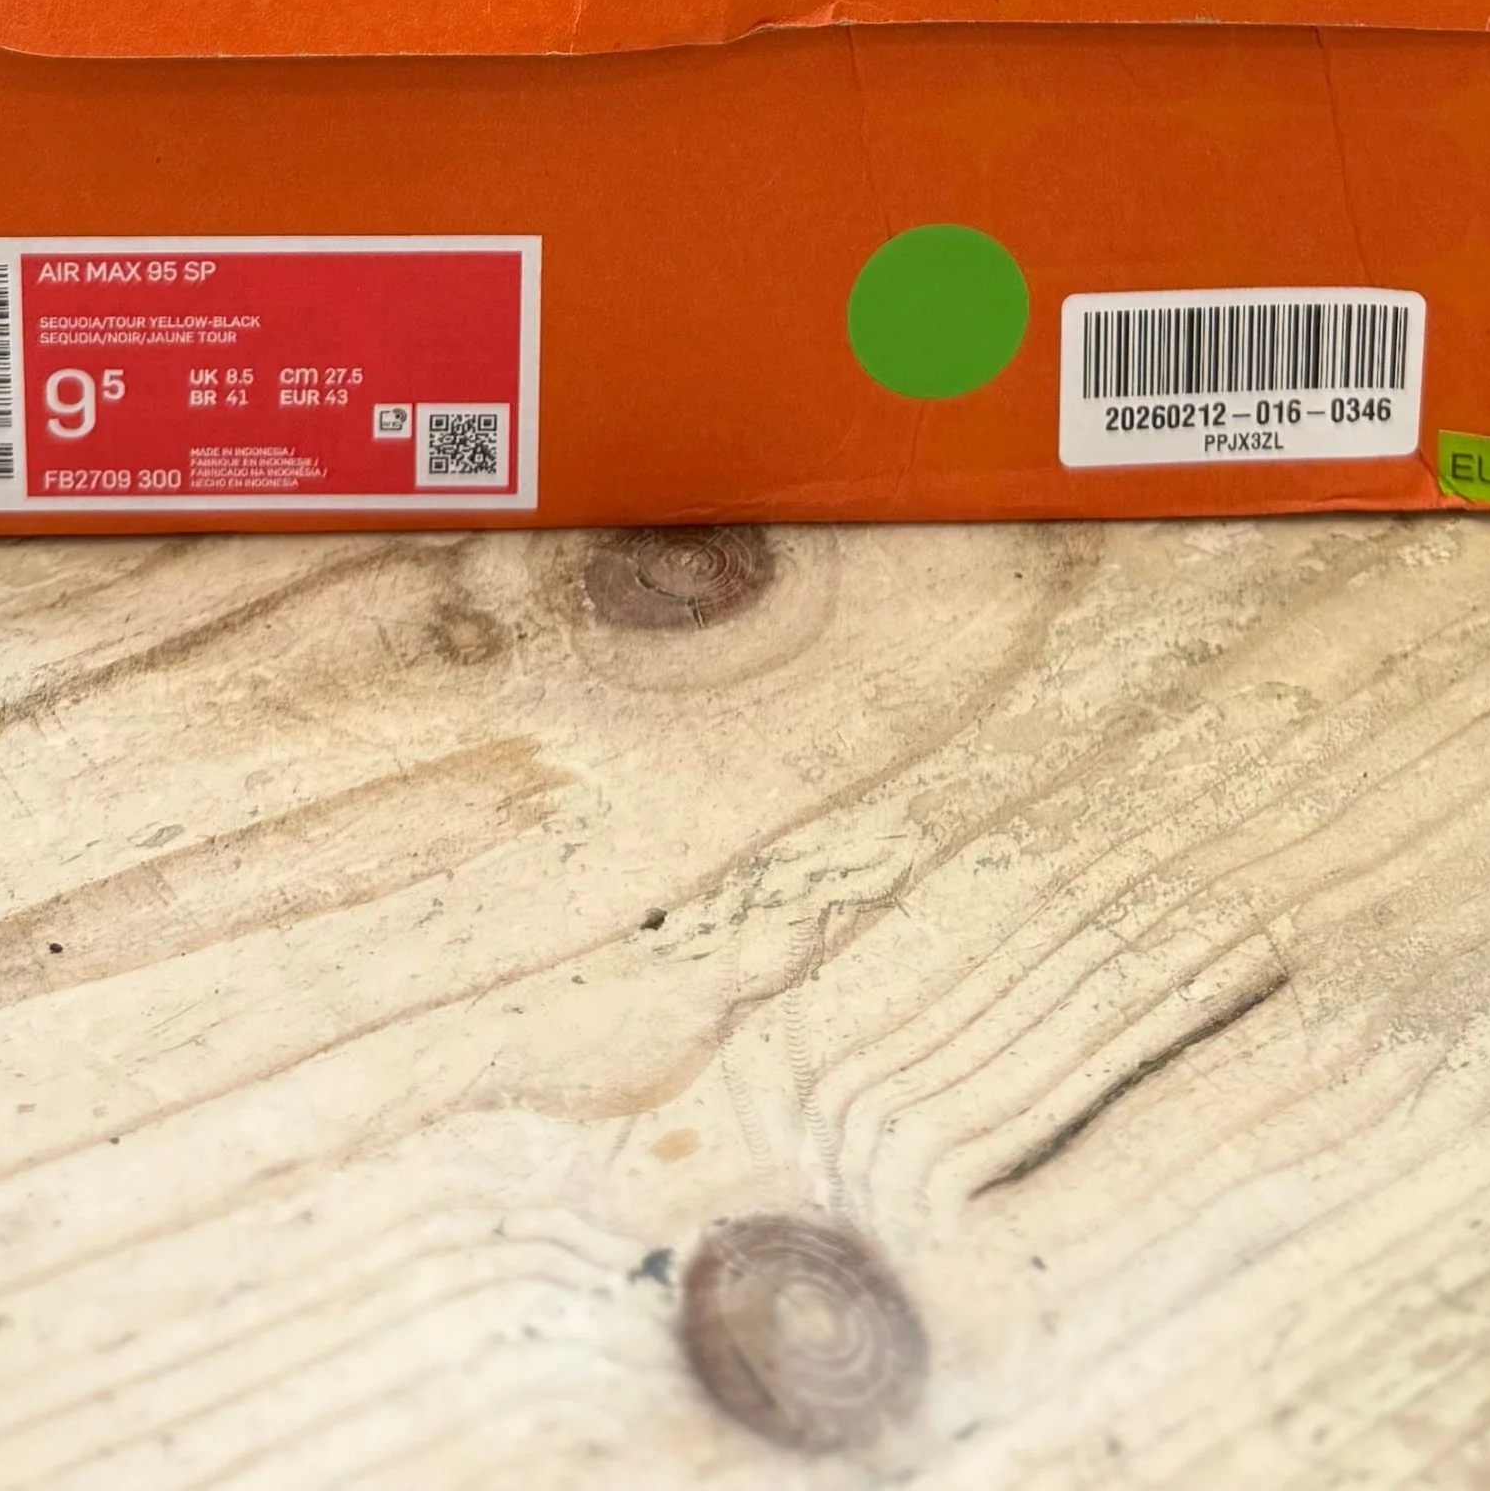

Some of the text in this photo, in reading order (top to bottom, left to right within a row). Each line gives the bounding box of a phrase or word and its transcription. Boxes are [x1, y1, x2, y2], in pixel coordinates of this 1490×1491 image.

[38, 261, 216, 282] AIR MAX 95 SP
[40, 315, 260, 329] SEQUOIA/TOUR YELLOW-BLACK
[199, 331, 237, 343] TOUR
[190, 369, 254, 385] UK 8.5
[325, 369, 363, 384] 27.5
[190, 390, 249, 405] BR 41
[280, 390, 349, 405] EUR 43
[1204, 432, 1284, 451] PPJX3ZL
[44, 470, 181, 489] FB2709 300
